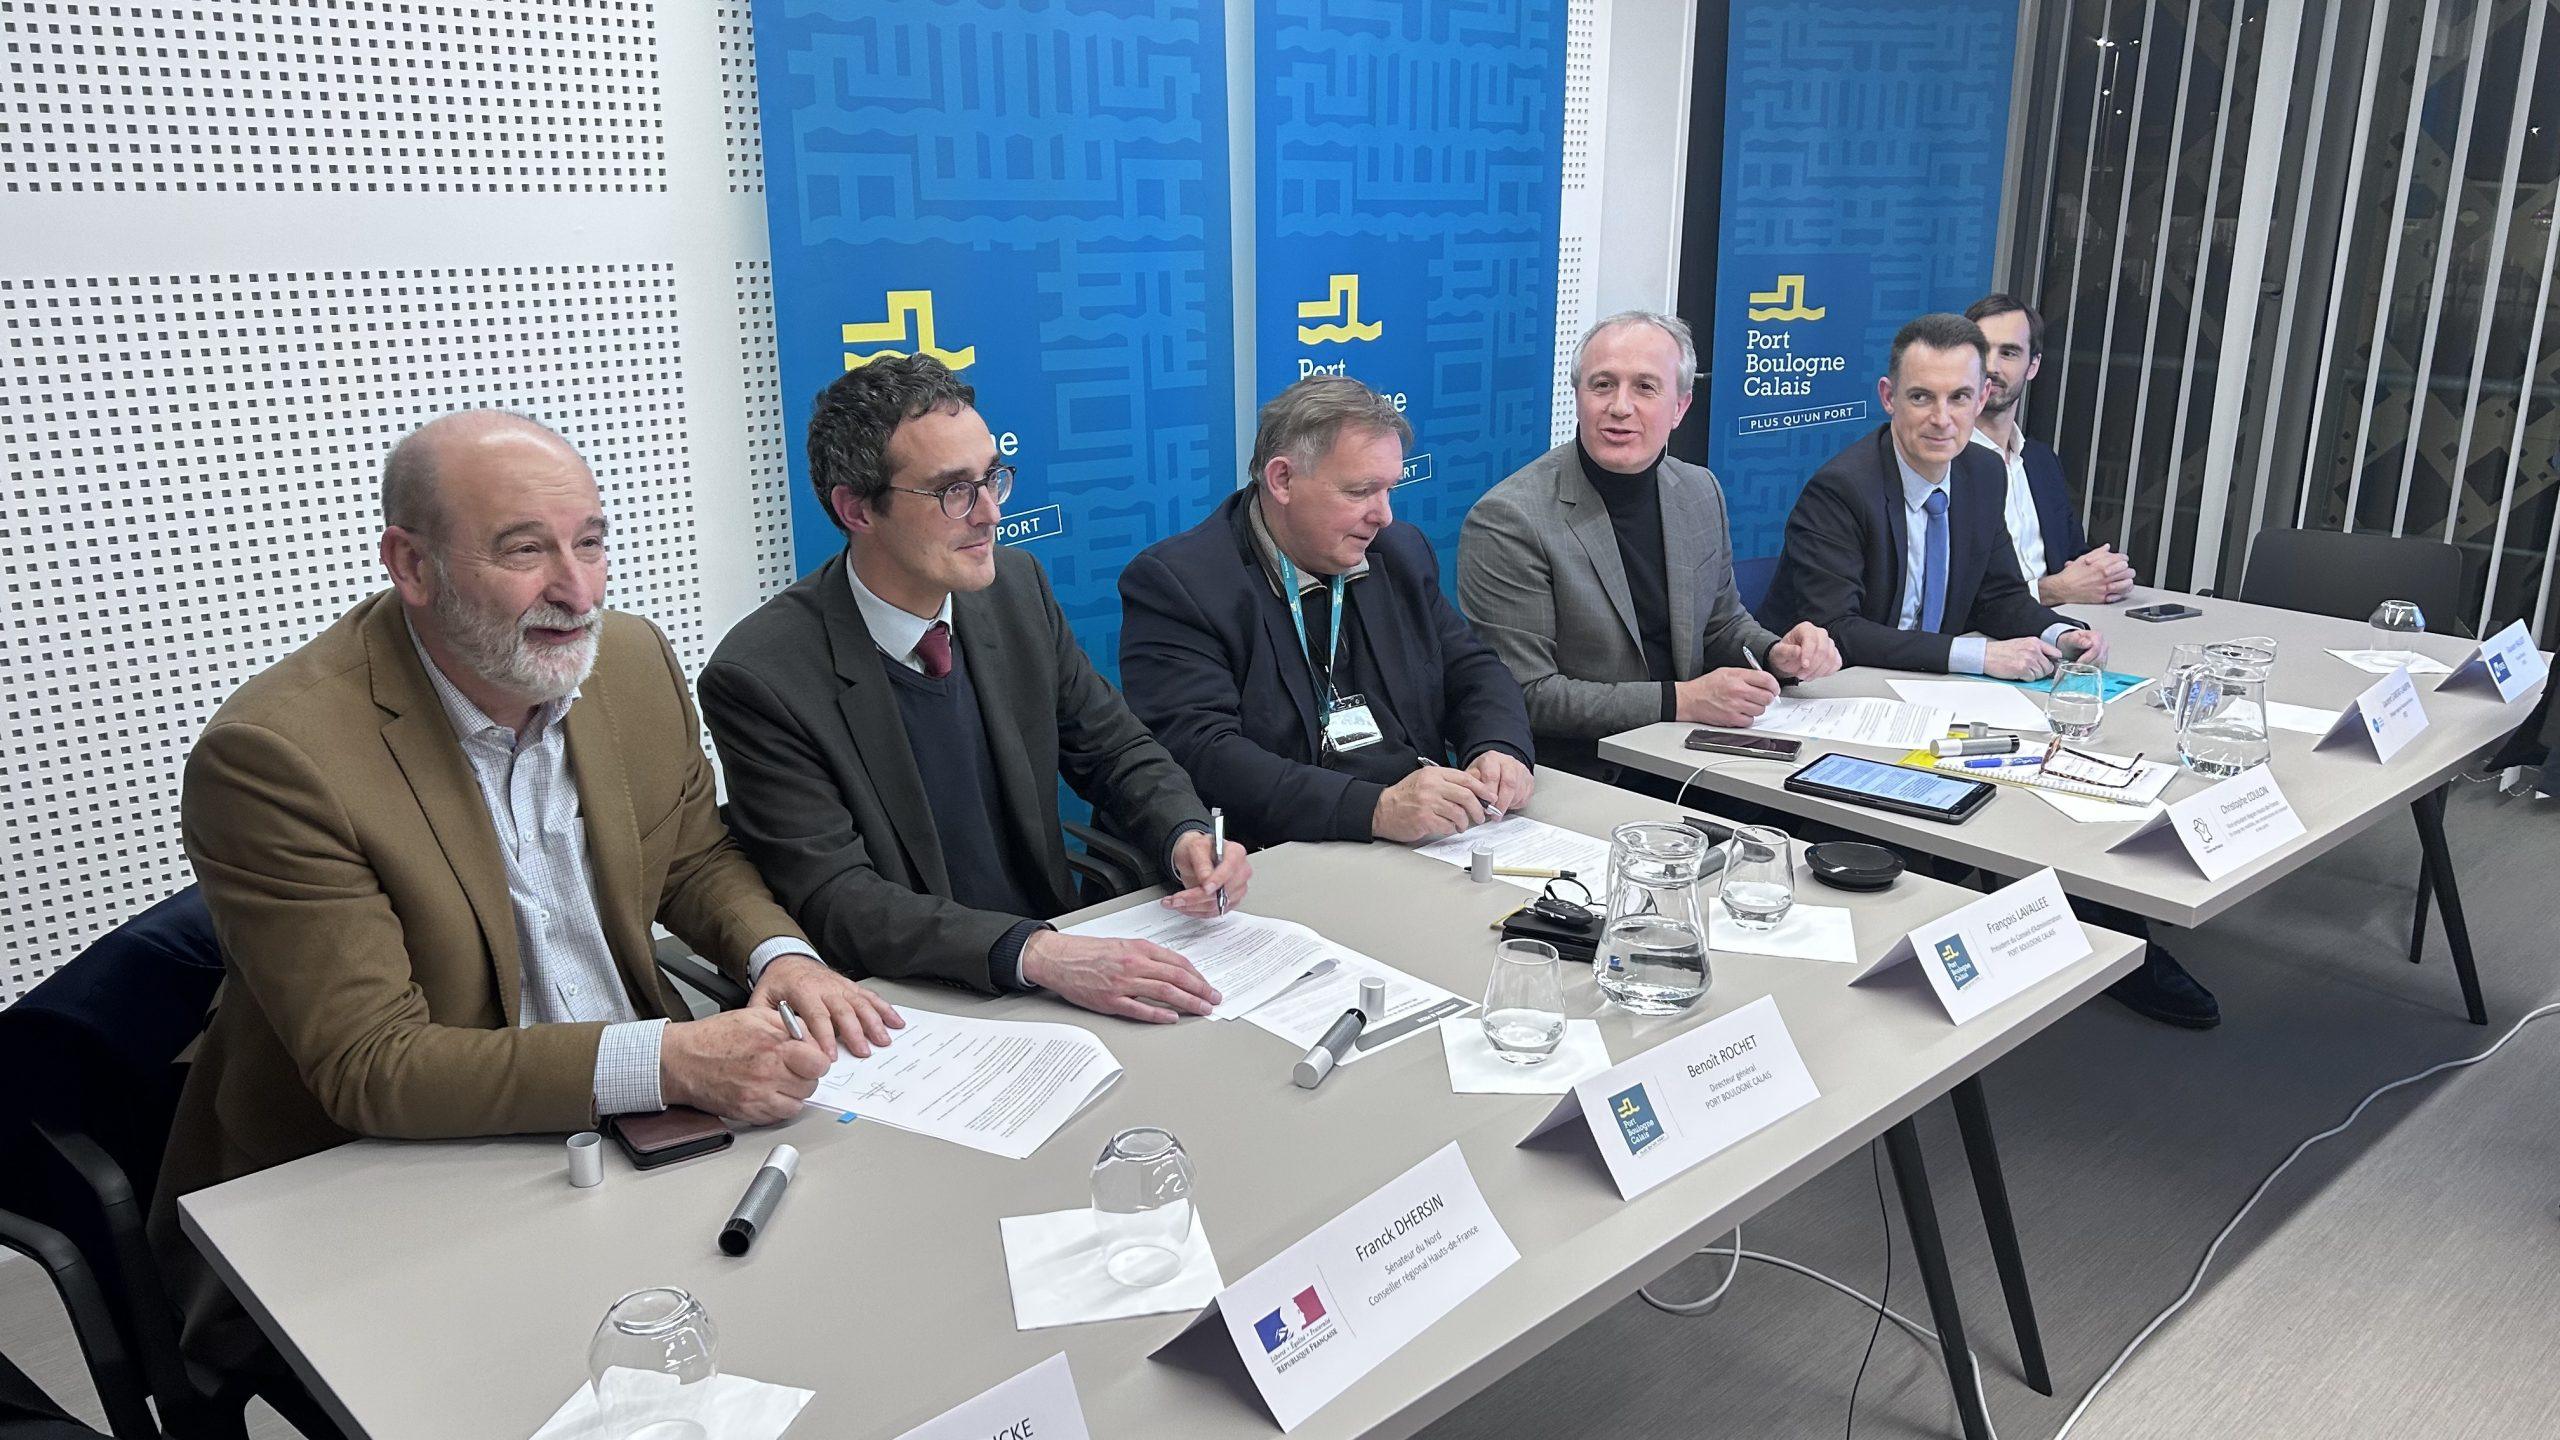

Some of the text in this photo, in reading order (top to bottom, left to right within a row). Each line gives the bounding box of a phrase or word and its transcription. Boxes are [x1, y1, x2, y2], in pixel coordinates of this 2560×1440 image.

[1747, 330, 1790, 349] Port
[1745, 353, 1845, 377] Boulogne
[1744, 376, 1811, 396] Calais
[1750, 408, 1854, 429] PLUS QU'UN PORT
[996, 517, 1040, 541] PORT
[1986, 913, 2017, 934] François
[1687, 1034, 1757, 1078] Benoît ROCHET
[1709, 1063, 1757, 1092] Directeur général
[1705, 1070, 1772, 1110] PORT BOULOGNE CALAIS
[1355, 1193, 1444, 1262] Franck DHERSIN
[1415, 1244, 1426, 1254] du
[1423, 1230, 1442, 1247] Nord
[1368, 1225, 1479, 1306] Conseiller régional Hauts-de-France
